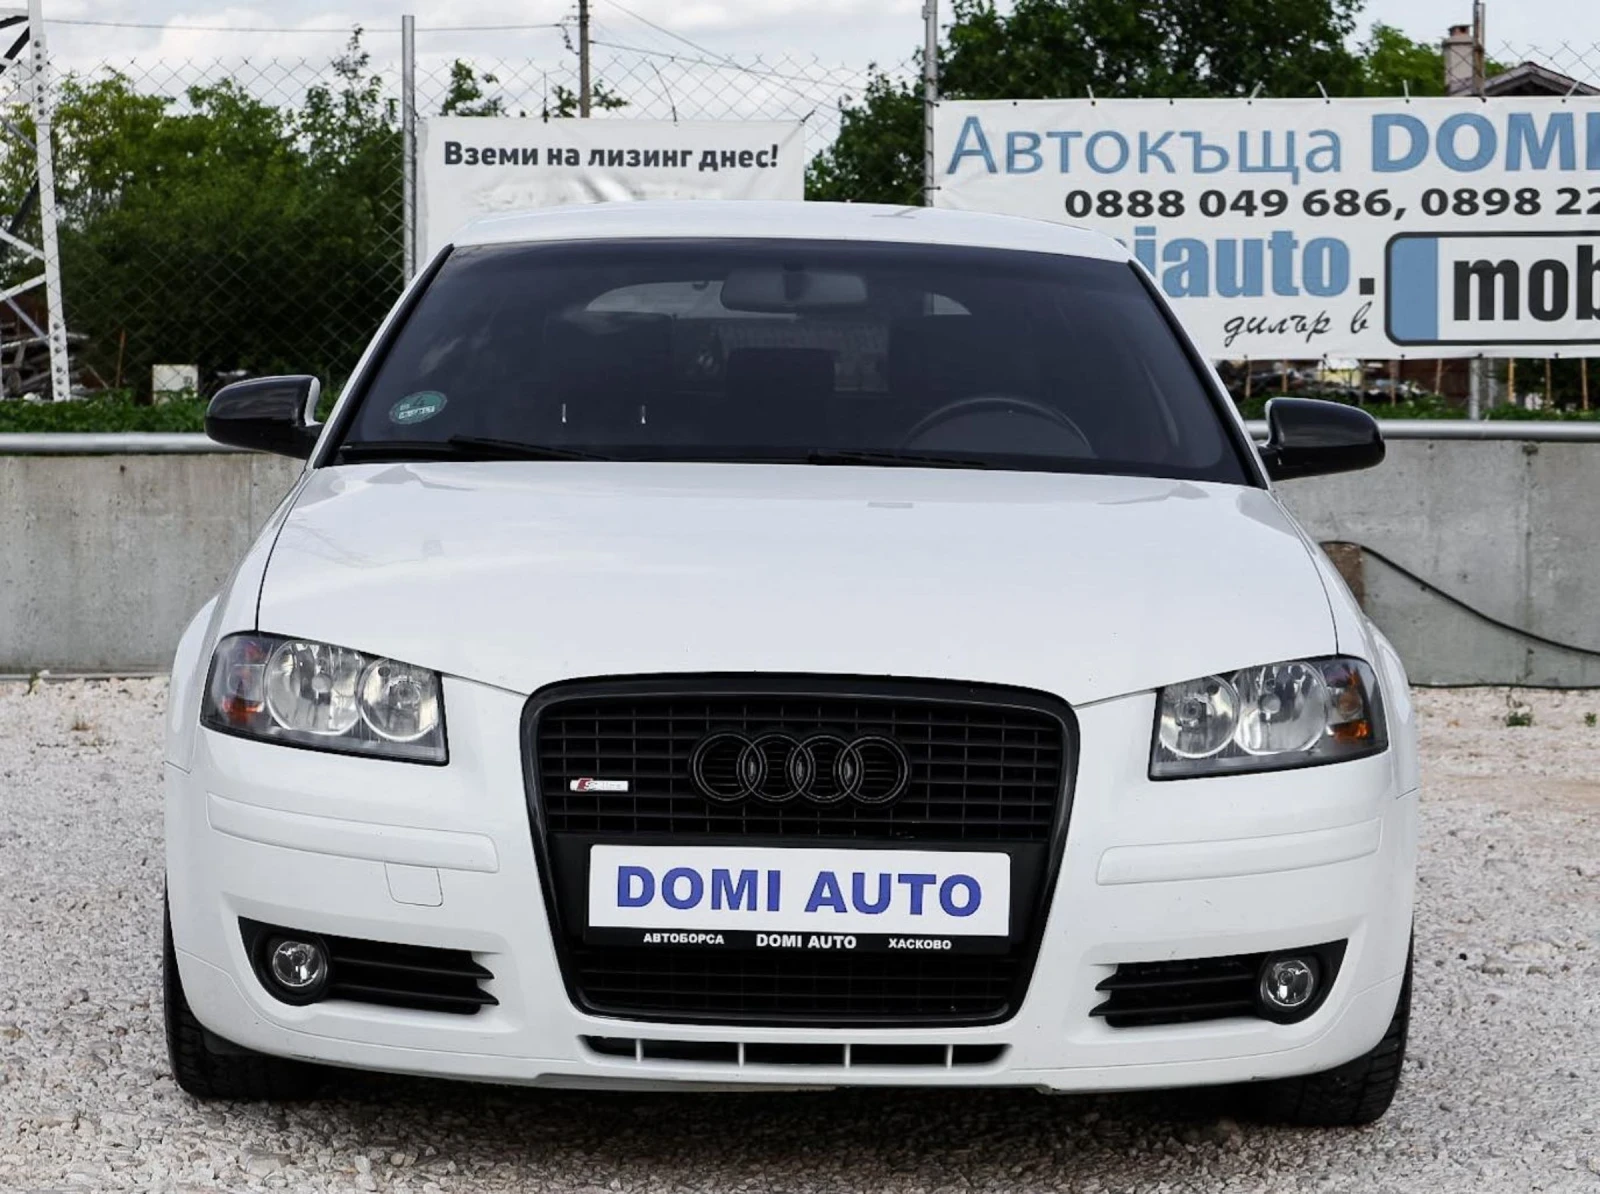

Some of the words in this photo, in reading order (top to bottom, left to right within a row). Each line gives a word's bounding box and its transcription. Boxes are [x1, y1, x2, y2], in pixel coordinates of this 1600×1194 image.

[443, 141, 539, 167] Вземи
[547, 147, 581, 167] на
[588, 149, 693, 169] лизинг
[699, 144, 780, 172] днес!
[946, 115, 1341, 185] Автокъща
[1371, 112, 1600, 173] DOMI
[1065, 189, 1186, 218] 0888
[1199, 189, 1289, 218] 049
[1302, 189, 1406, 221] 686,
[1420, 187, 1542, 216] 0898
[617, 865, 781, 912] DOMI
[804, 871, 982, 917] AUTO
[643, 932, 725, 945] АВТОБОРСА
[756, 933, 803, 948] DOMI
[807, 935, 857, 949] AUTO
[888, 937, 952, 950] ХАСКОВО
